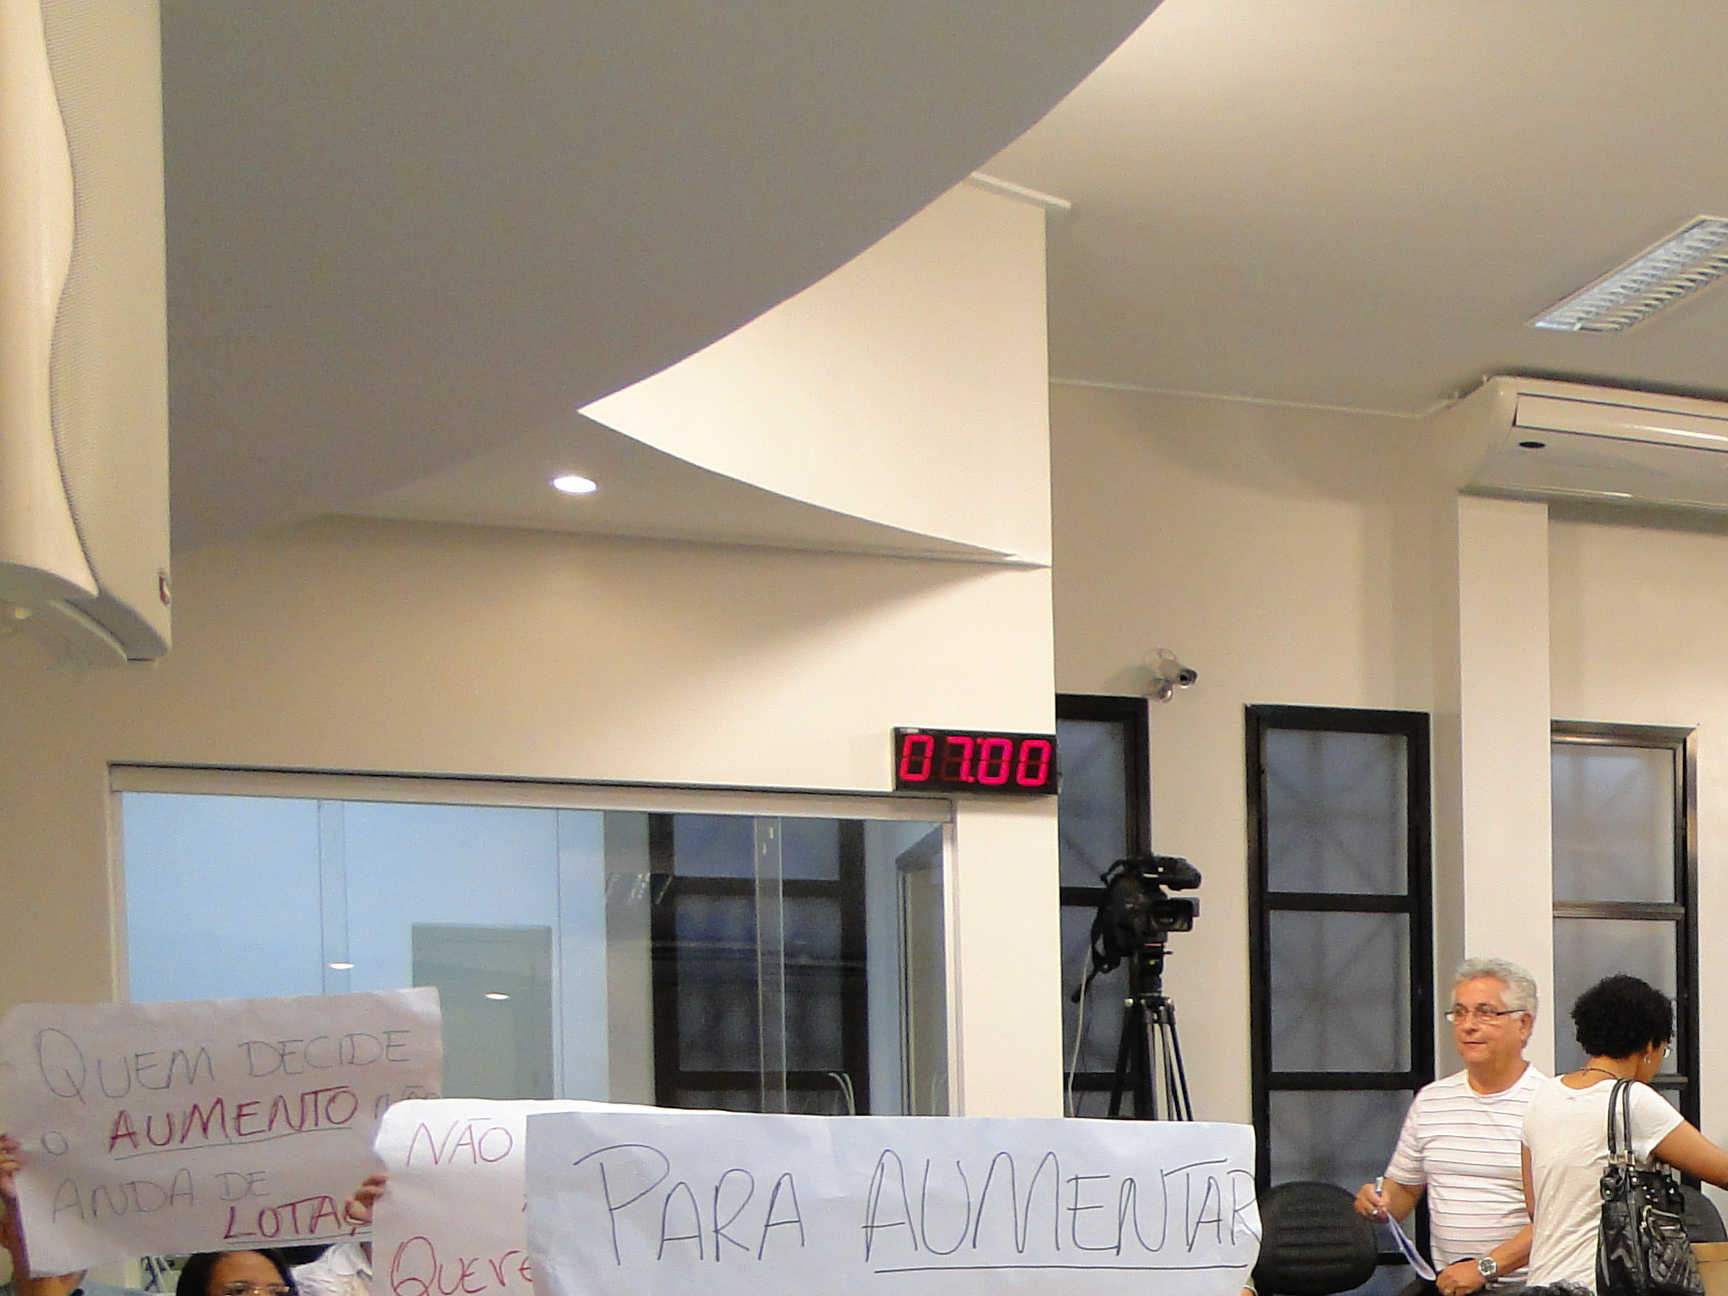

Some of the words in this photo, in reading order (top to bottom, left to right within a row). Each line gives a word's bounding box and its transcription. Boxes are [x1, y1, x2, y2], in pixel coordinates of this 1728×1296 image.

[36, 1027, 216, 1104] QUEM
[238, 1030, 411, 1078] DECIDE
[109, 1085, 359, 1153] AUMENTO
[407, 1116, 514, 1167] NÃO
[52, 1168, 195, 1223] ANDA
[215, 1169, 269, 1201] DE
[574, 1143, 806, 1267] PARA
[862, 1147, 1261, 1262] AUMENTAR
